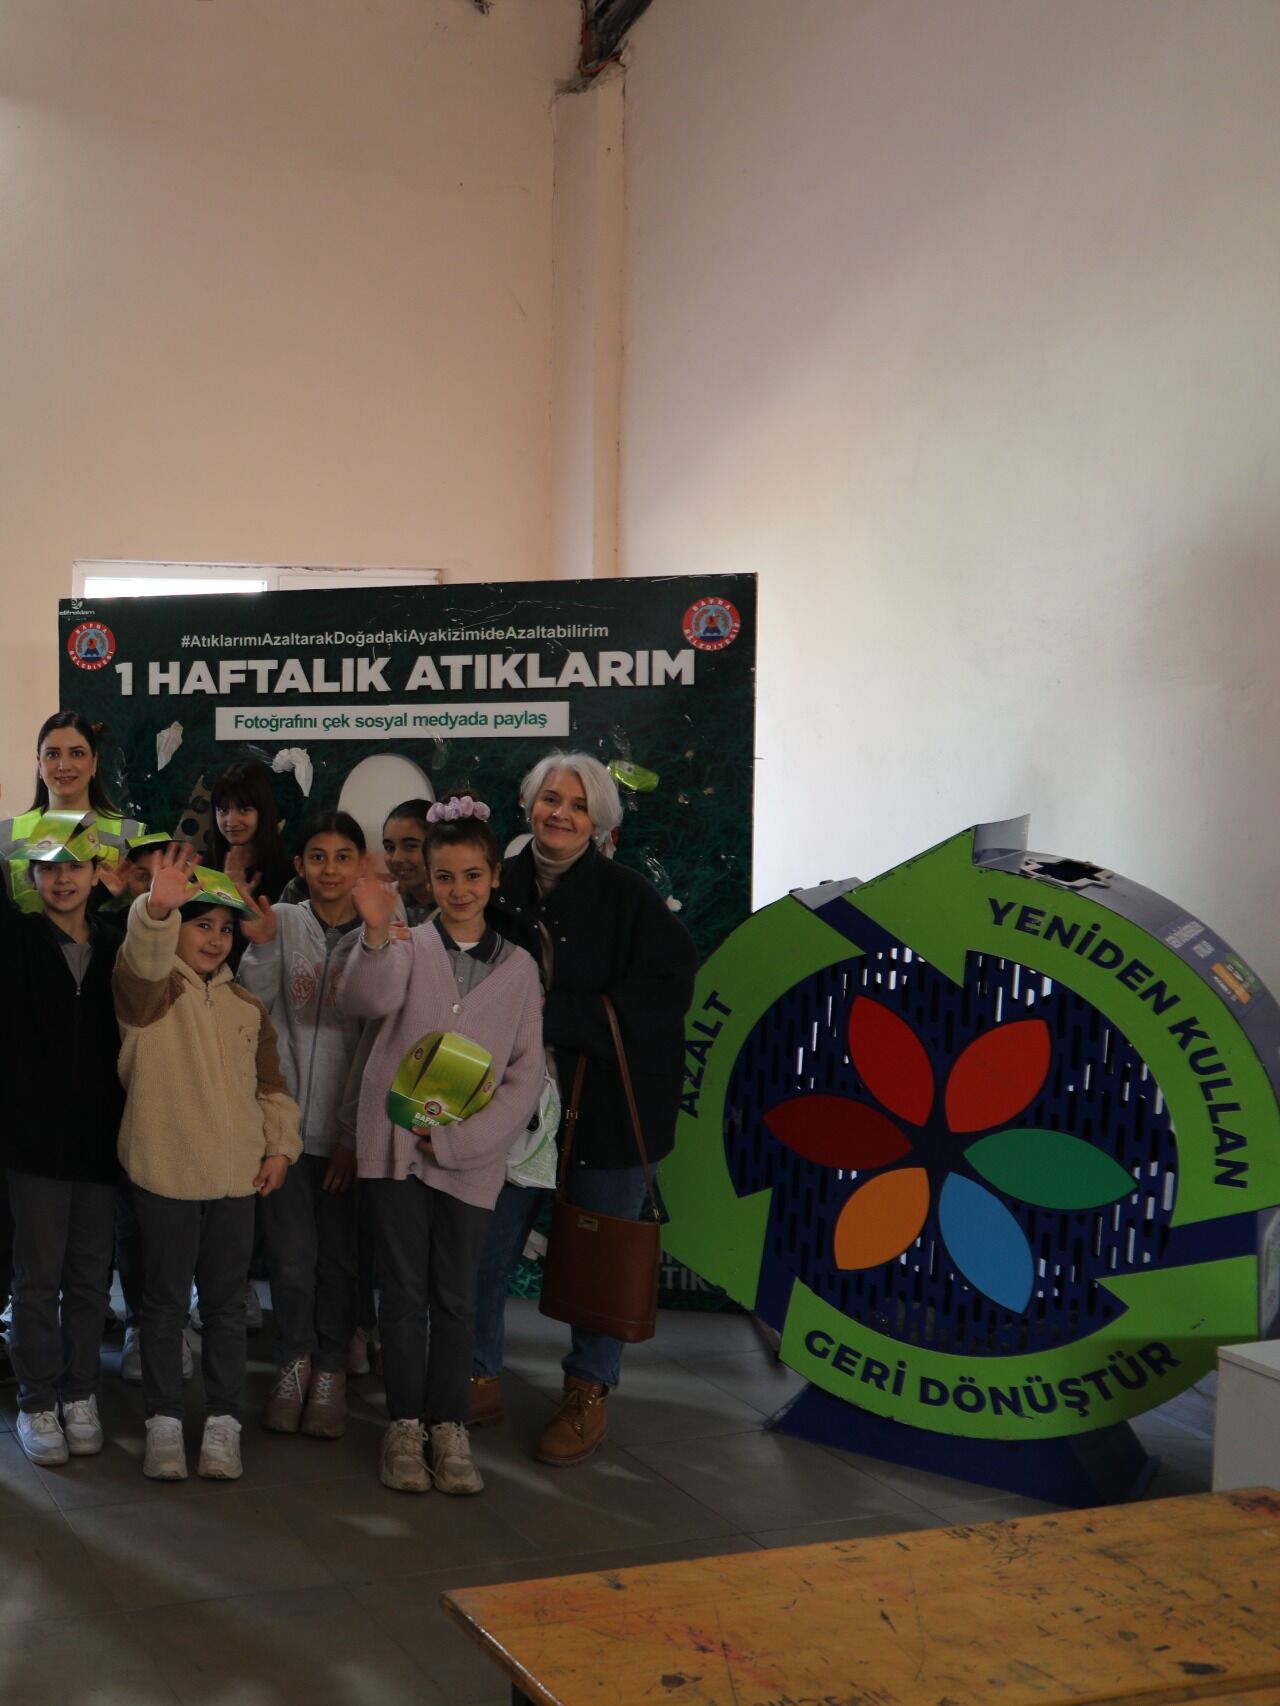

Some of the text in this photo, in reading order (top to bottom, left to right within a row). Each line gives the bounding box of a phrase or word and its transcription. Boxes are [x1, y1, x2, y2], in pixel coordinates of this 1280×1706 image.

[115, 649, 695, 696] 1 HAFTALIK ATIKLARIM
[233, 708, 547, 733] Fotoğrafını çek sosyal medyada paylaş
[680, 990, 732, 1119] AZALT
[988, 898, 1248, 1189] YENİDEN KULLAN
[656, 1265, 712, 1292] TIK
[804, 1329, 1181, 1419] GERİ DÖNÜŞTÜR
